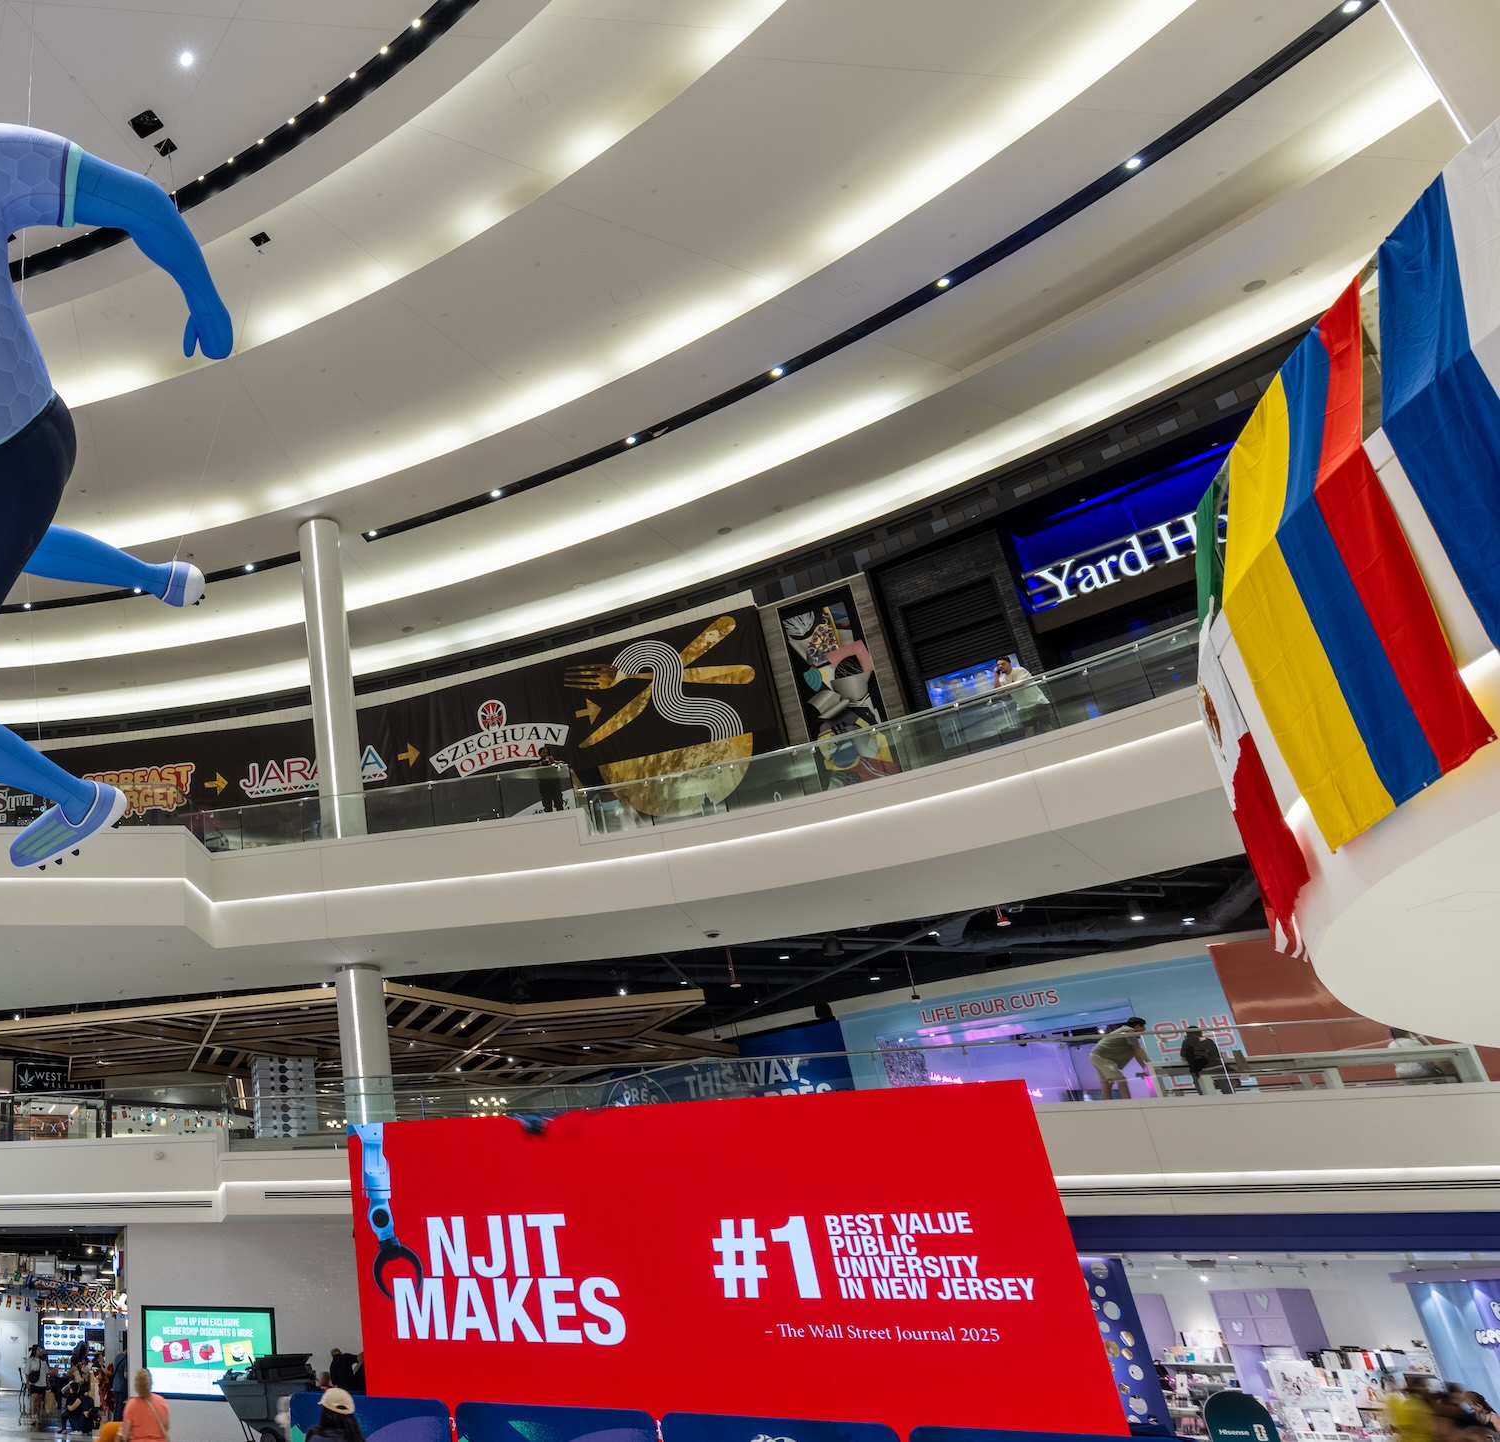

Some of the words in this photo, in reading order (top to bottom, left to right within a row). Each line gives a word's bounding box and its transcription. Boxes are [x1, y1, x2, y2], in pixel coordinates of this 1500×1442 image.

[1035, 534, 1156, 603] Yard
[436, 725, 563, 770] SZECHUAN
[460, 743, 539, 773] OPERA
[921, 1006, 957, 1025] LIFE
[958, 998, 1007, 1018] FOUR
[1009, 989, 1060, 1010] CUTS
[43, 1081, 94, 1090] WELLNESS
[684, 1067, 737, 1099] THIS
[741, 1058, 800, 1088] WAY
[824, 1213, 884, 1236] BEST
[891, 1212, 973, 1235] VALUE
[426, 1213, 567, 1278] NJIT
[712, 1215, 822, 1299] #1
[829, 1233, 918, 1257] PUBLIC
[833, 1255, 979, 1279] UNIVERSITY
[838, 1277, 866, 1299] IN
[873, 1277, 928, 1300] NEW
[937, 1277, 1034, 1301] JERSEY
[174, 1317, 188, 1326] SIGN
[189, 1317, 197, 1326] UP
[198, 1317, 209, 1326] FOR
[210, 1318, 240, 1327] EXCLUSIVE
[393, 1276, 627, 1346] MAKES
[162, 1326, 198, 1336] MEMBERSHIP
[200, 1327, 230, 1337] DISCOUNTS
[237, 1328, 254, 1338] MORE
[777, 1323, 805, 1339] The
[808, 1323, 844, 1340] Wall
[847, 1324, 892, 1341] Street
[896, 1325, 957, 1343] Journal
[960, 1327, 1001, 1343] 2025
[1219, 1428, 1250, 1437] Hisense
